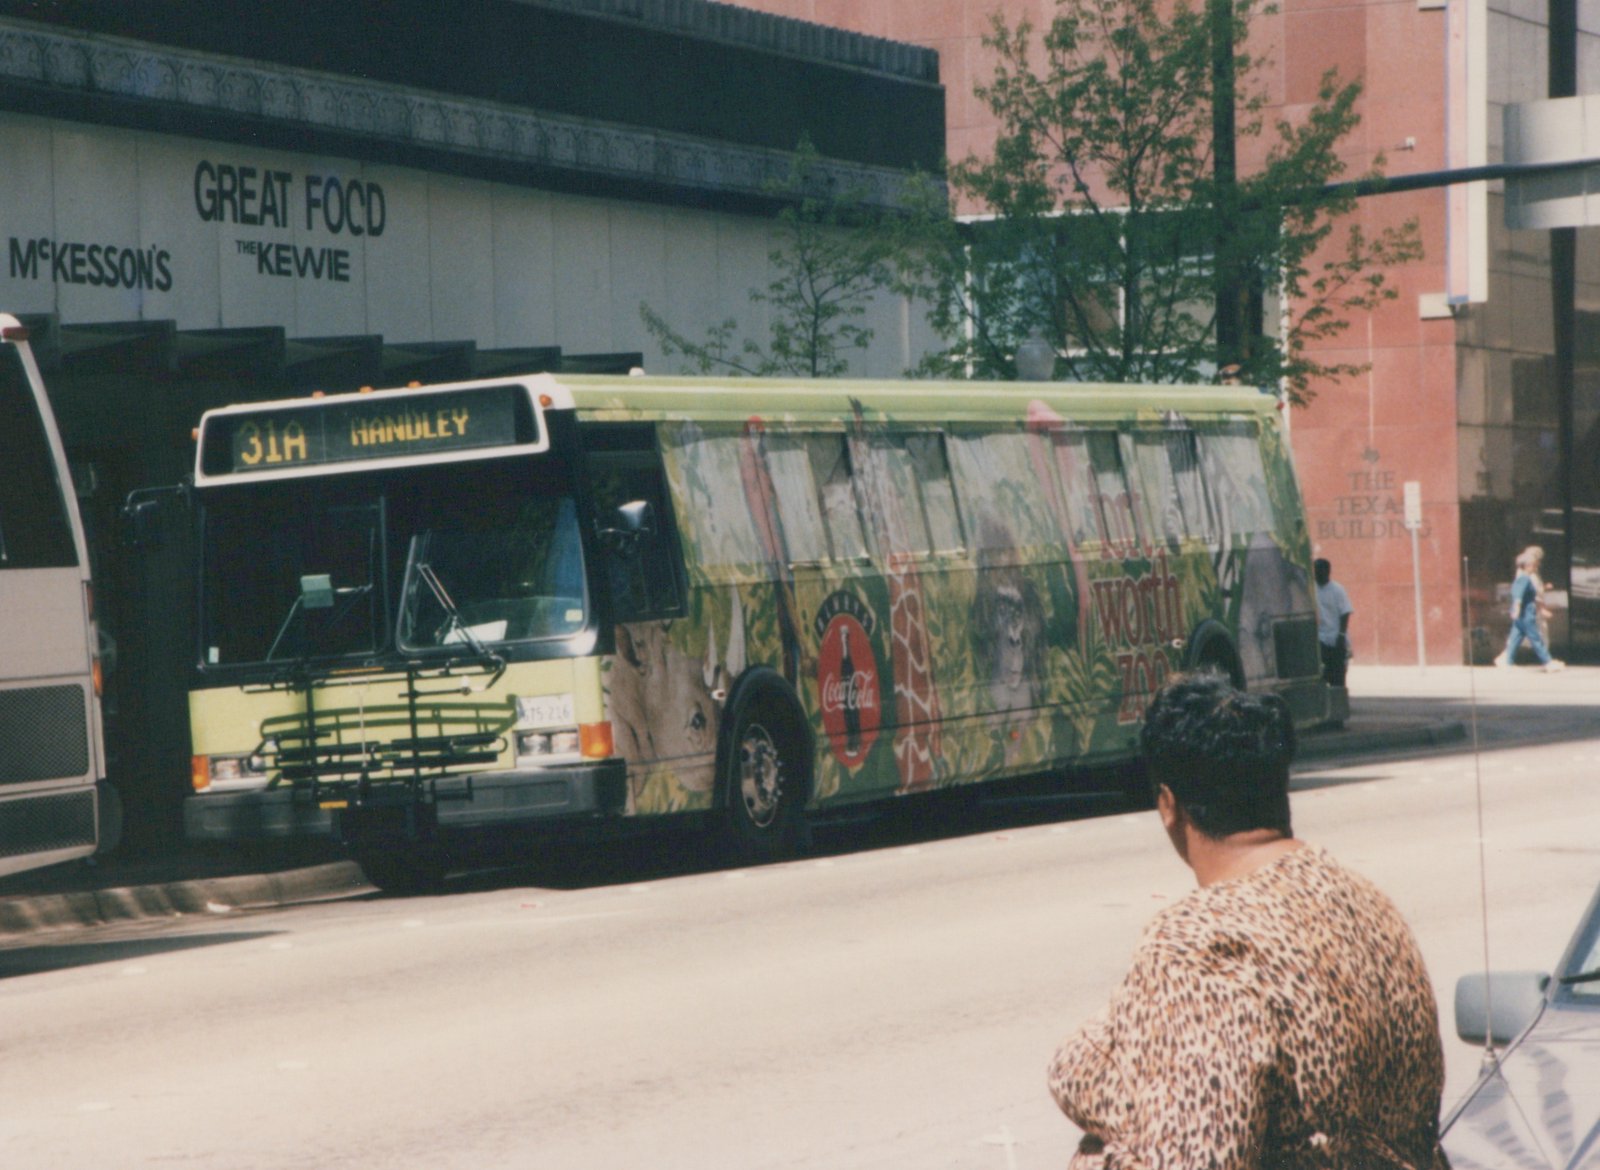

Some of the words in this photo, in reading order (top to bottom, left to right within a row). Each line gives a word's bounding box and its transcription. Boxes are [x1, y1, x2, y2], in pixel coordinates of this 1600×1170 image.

[194, 159, 293, 229] GREAT
[236, 239, 257, 255] THE
[239, 418, 307, 465] 31A
[351, 407, 469, 447] HANDLEY
[1347, 471, 1397, 491] THE
[1334, 496, 1405, 516] TEXA
